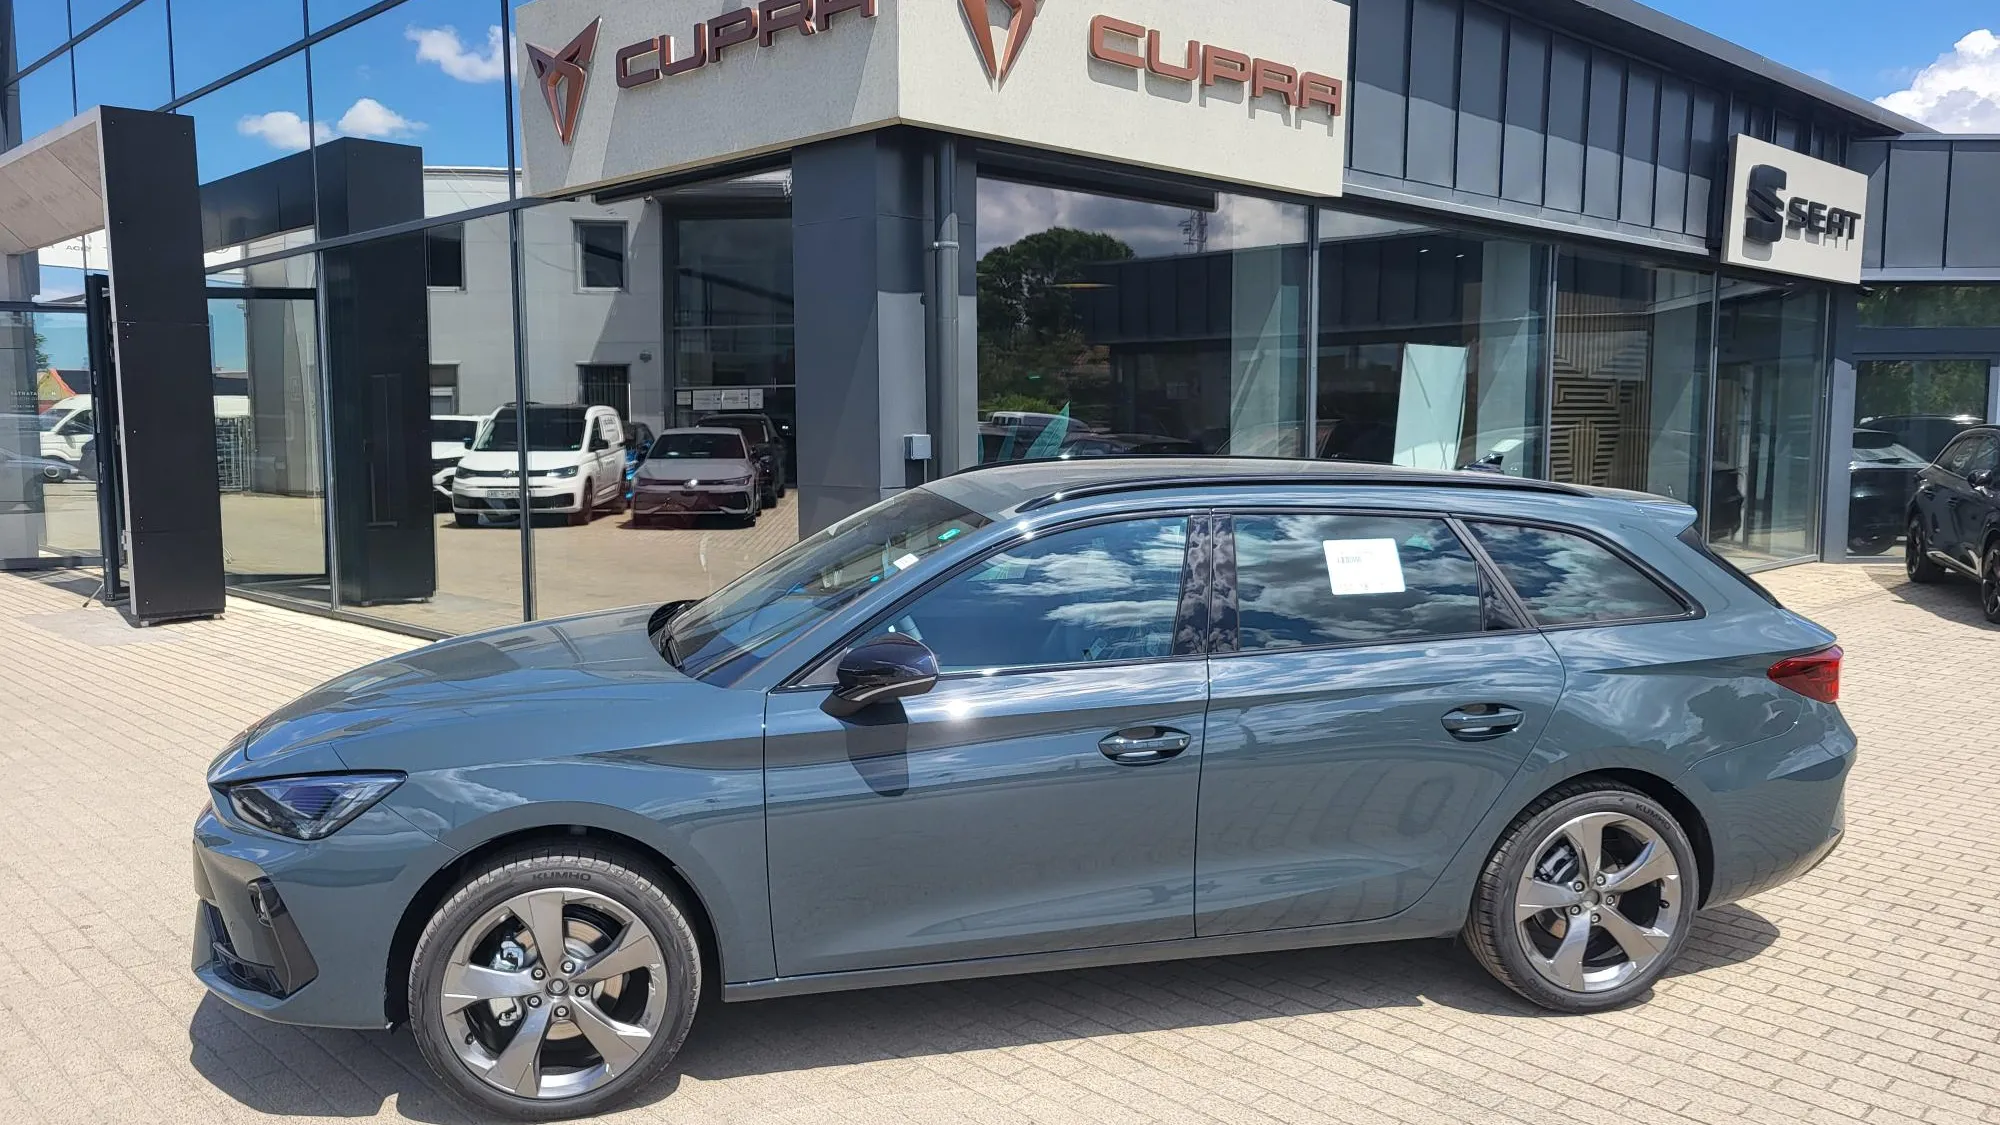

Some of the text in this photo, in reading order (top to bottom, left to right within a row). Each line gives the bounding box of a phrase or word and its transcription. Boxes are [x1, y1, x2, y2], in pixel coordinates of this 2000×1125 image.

[1090, 14, 1342, 116] CUPRA
[1788, 196, 1861, 240] SEAT
[532, 870, 592, 881] KUMHO
